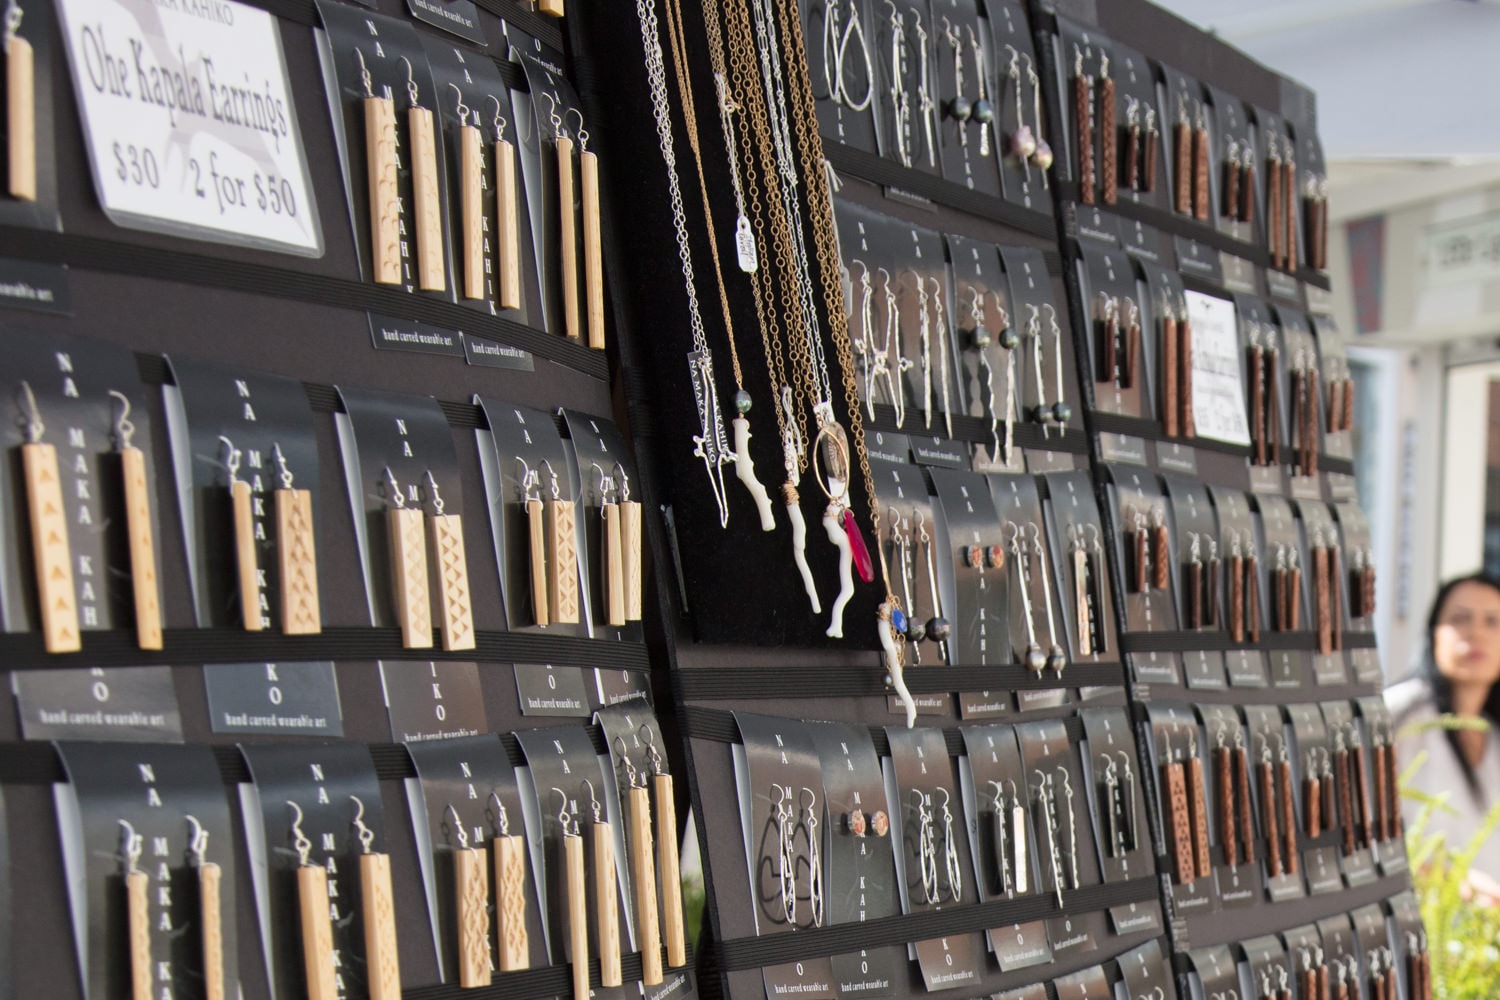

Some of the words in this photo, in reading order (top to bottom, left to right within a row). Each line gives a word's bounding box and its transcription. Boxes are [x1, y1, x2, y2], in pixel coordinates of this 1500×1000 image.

[81, 24, 133, 98] Ohe
[129, 38, 207, 128] Kapala
[203, 56, 288, 154] Earrings
[113, 141, 160, 190] $30
[190, 157, 206, 199] 2
[209, 150, 247, 214] for
[253, 172, 297, 218] $50
[482, 216, 498, 316] KAHIK
[68, 427, 92, 525] MAKA
[249, 450, 267, 541] MAKA
[154, 837, 173, 932] MAKA
[322, 832, 342, 921] MAKA
